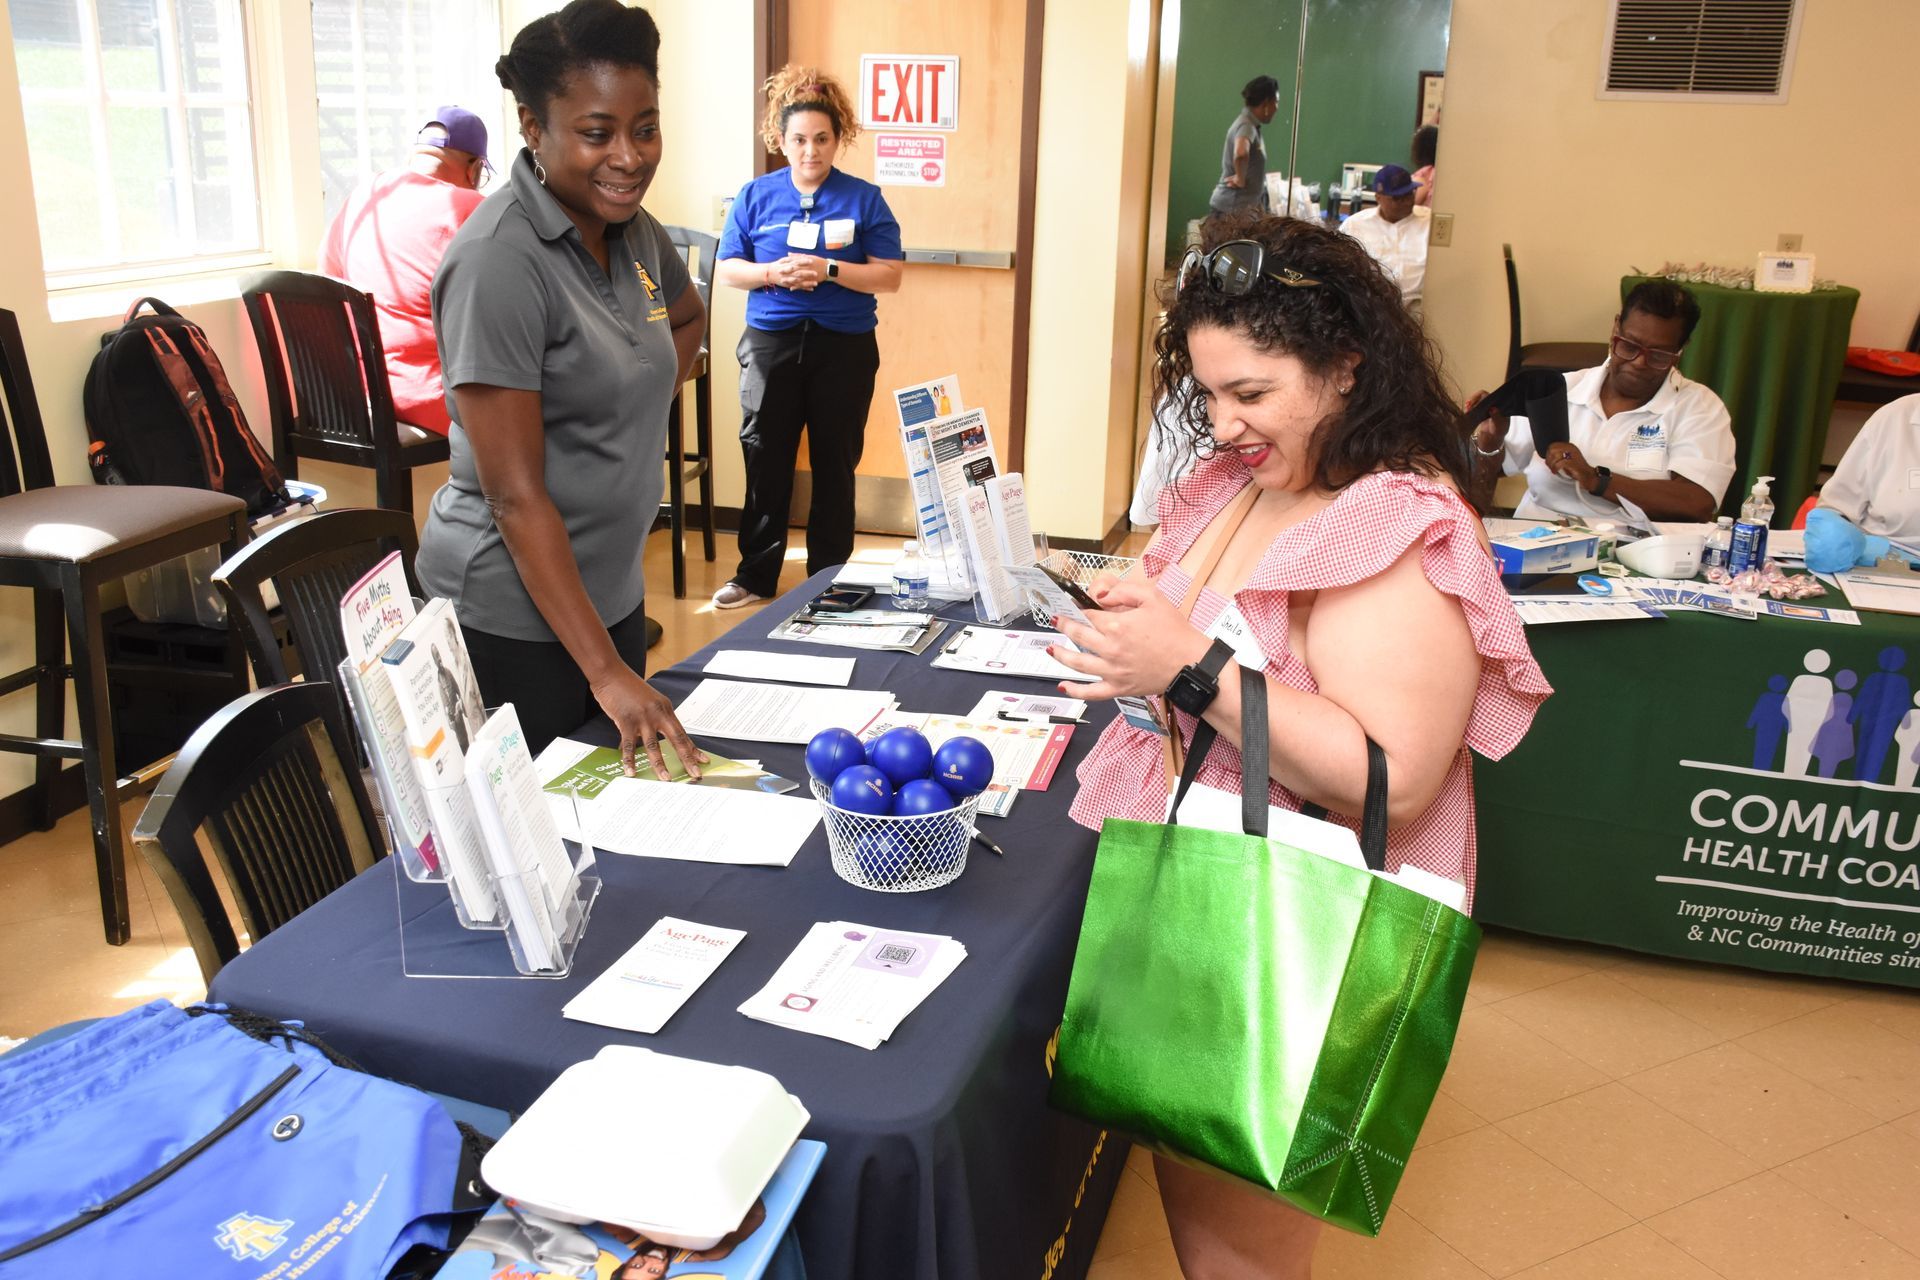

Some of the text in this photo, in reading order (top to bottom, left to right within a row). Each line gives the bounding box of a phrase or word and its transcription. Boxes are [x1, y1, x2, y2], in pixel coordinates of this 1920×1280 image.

[871, 63, 946, 124] EXIT
[880, 138, 941, 149] RESTRICTED
[897, 148, 924, 157] AREA
[879, 169, 907, 178] PERSONNEL
[884, 161, 915, 170] AUTHORIZED
[923, 167, 939, 177] STOP
[958, 417, 981, 427] DEMENTIA
[355, 577, 392, 623] Five Myths
[362, 604, 403, 654] About Aging
[1221, 614, 1242, 637] Sheila
[595, 761, 620, 773] Older
[606, 767, 621, 776] and
[1683, 837, 1829, 879] HEALTH
[1677, 900, 1783, 931] Improving
[1790, 915, 1822, 933] the
[1826, 919, 1897, 943] Health
[1687, 924, 1703, 941] &
[1709, 927, 1743, 945] NC
[1747, 932, 1883, 964] Communities
[290, 1216, 343, 1260] College
[342, 1200, 358, 1216] of
[286, 1235, 343, 1280] Human
